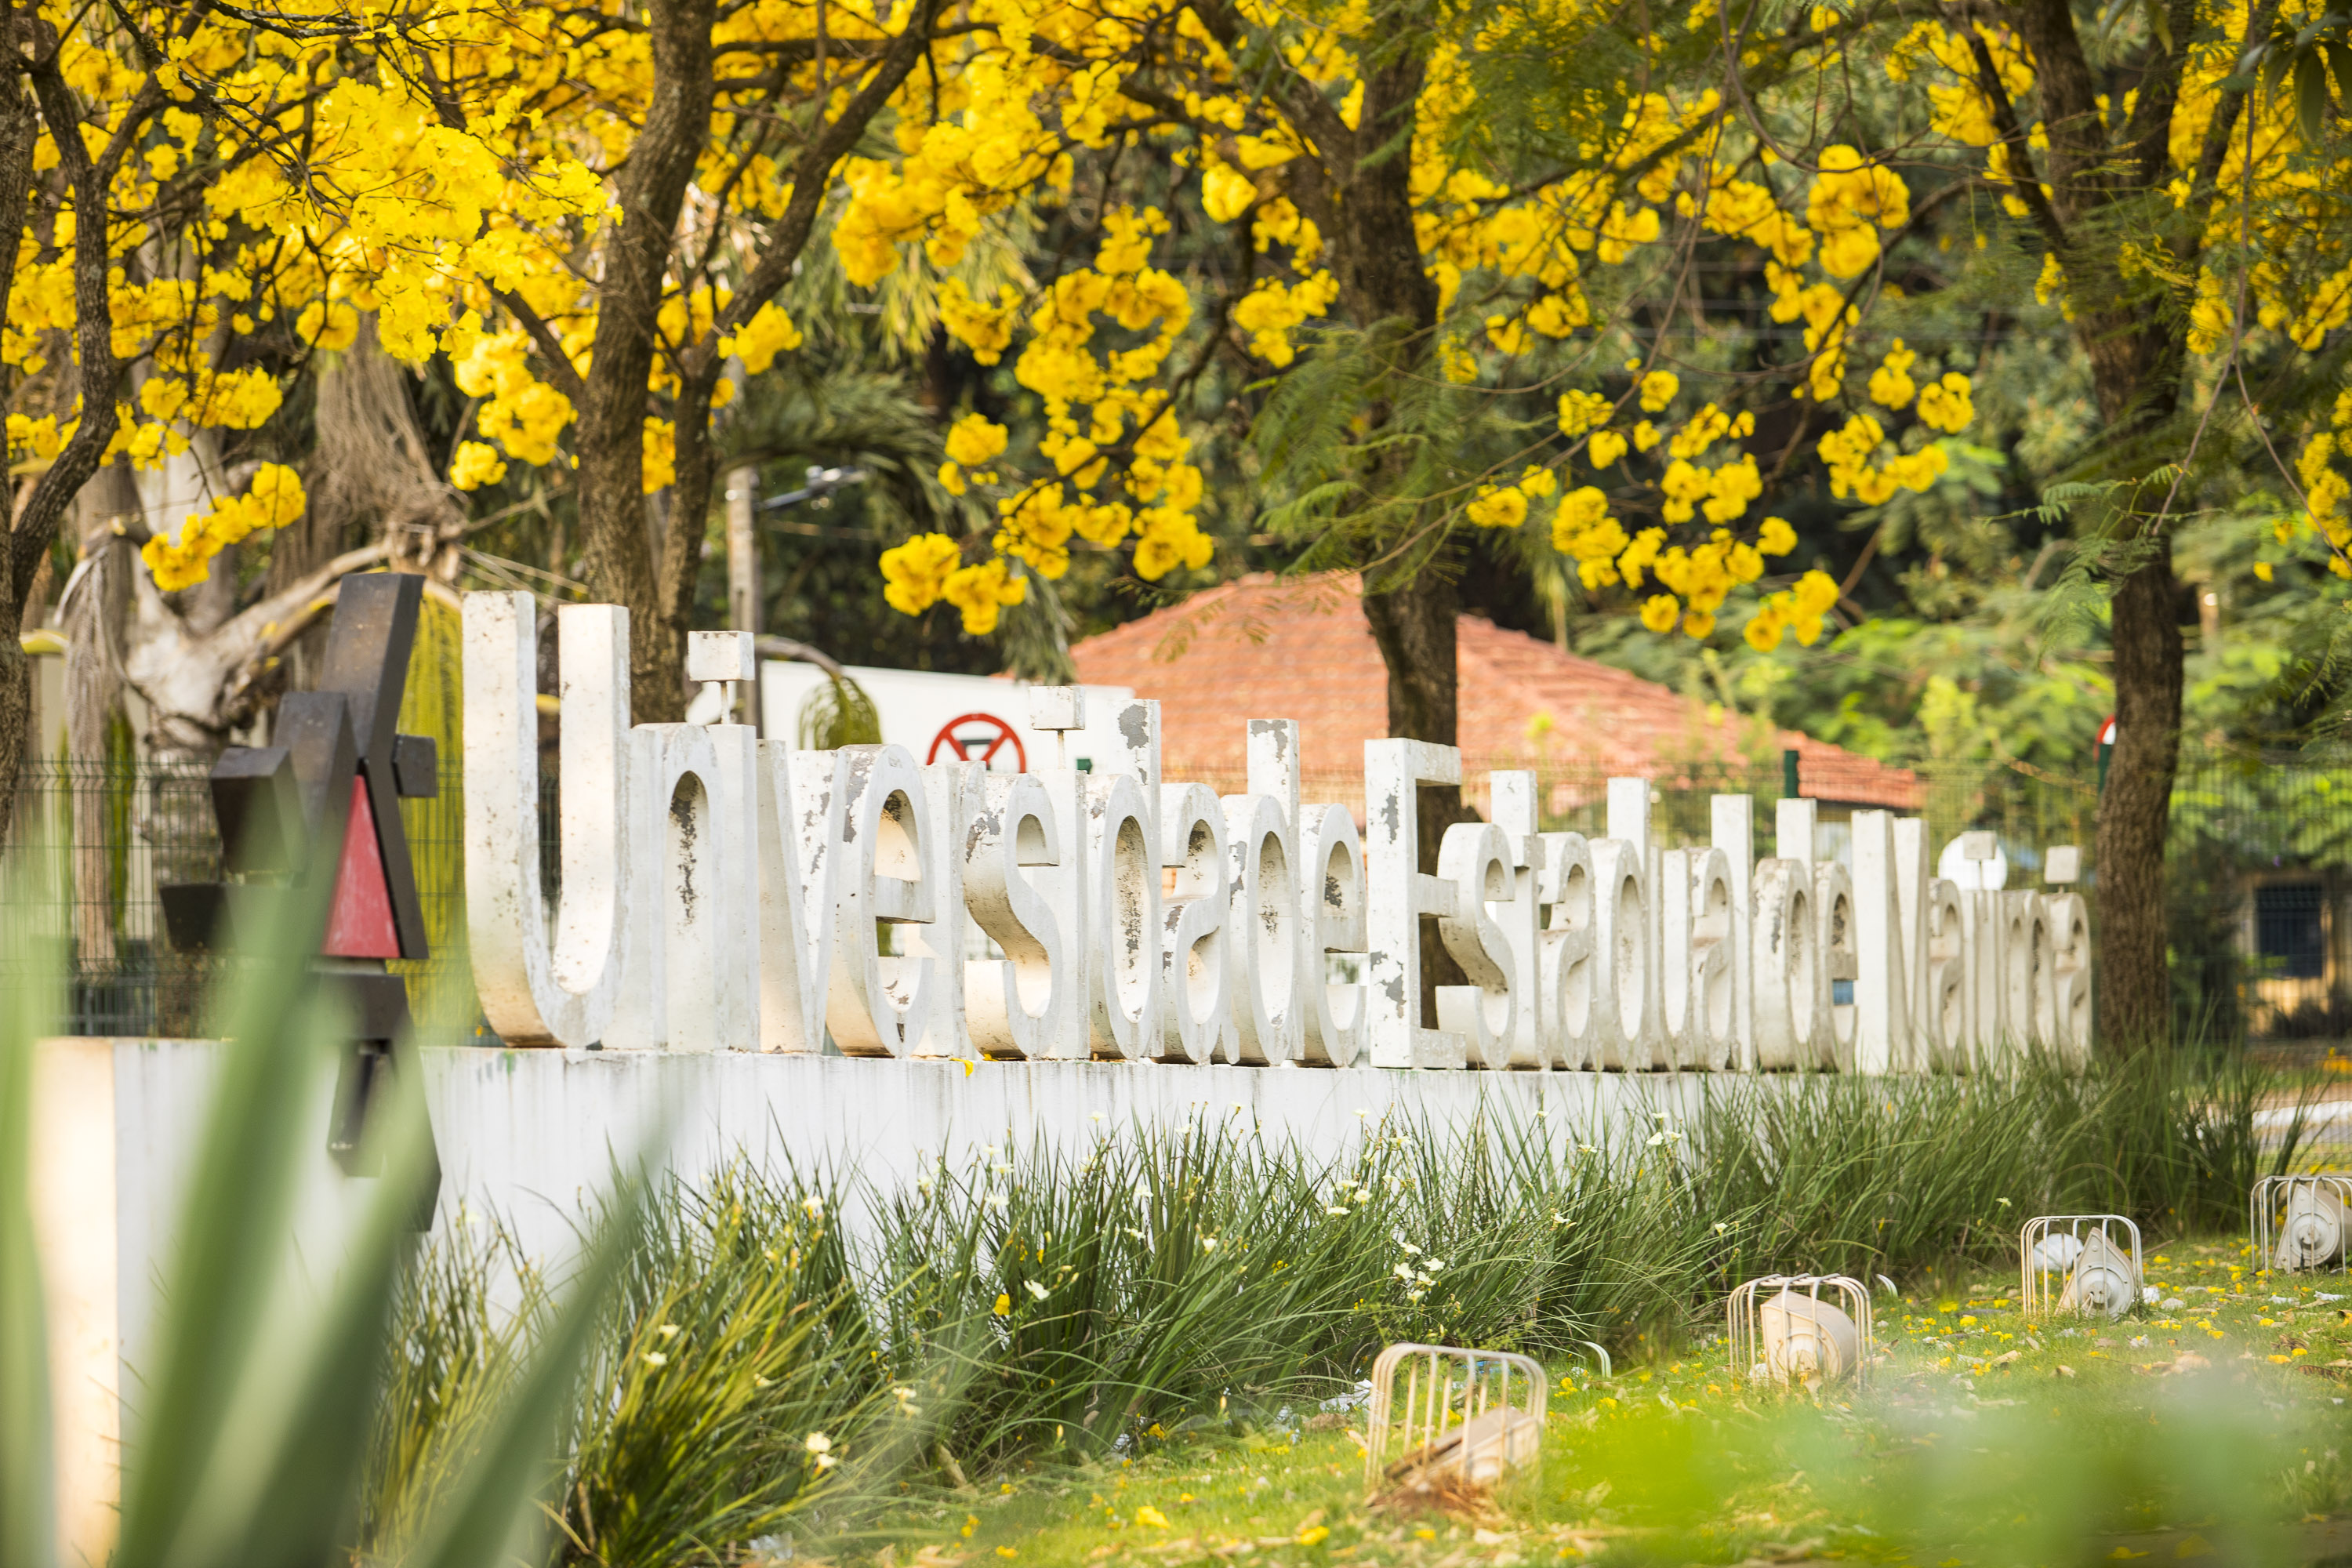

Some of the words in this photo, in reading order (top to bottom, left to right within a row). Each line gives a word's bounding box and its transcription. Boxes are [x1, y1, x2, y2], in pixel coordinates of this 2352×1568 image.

[462, 590, 1368, 1068] Universidade
[1364, 737, 1753, 1073] Estadual
[1753, 798, 1857, 1074] de
